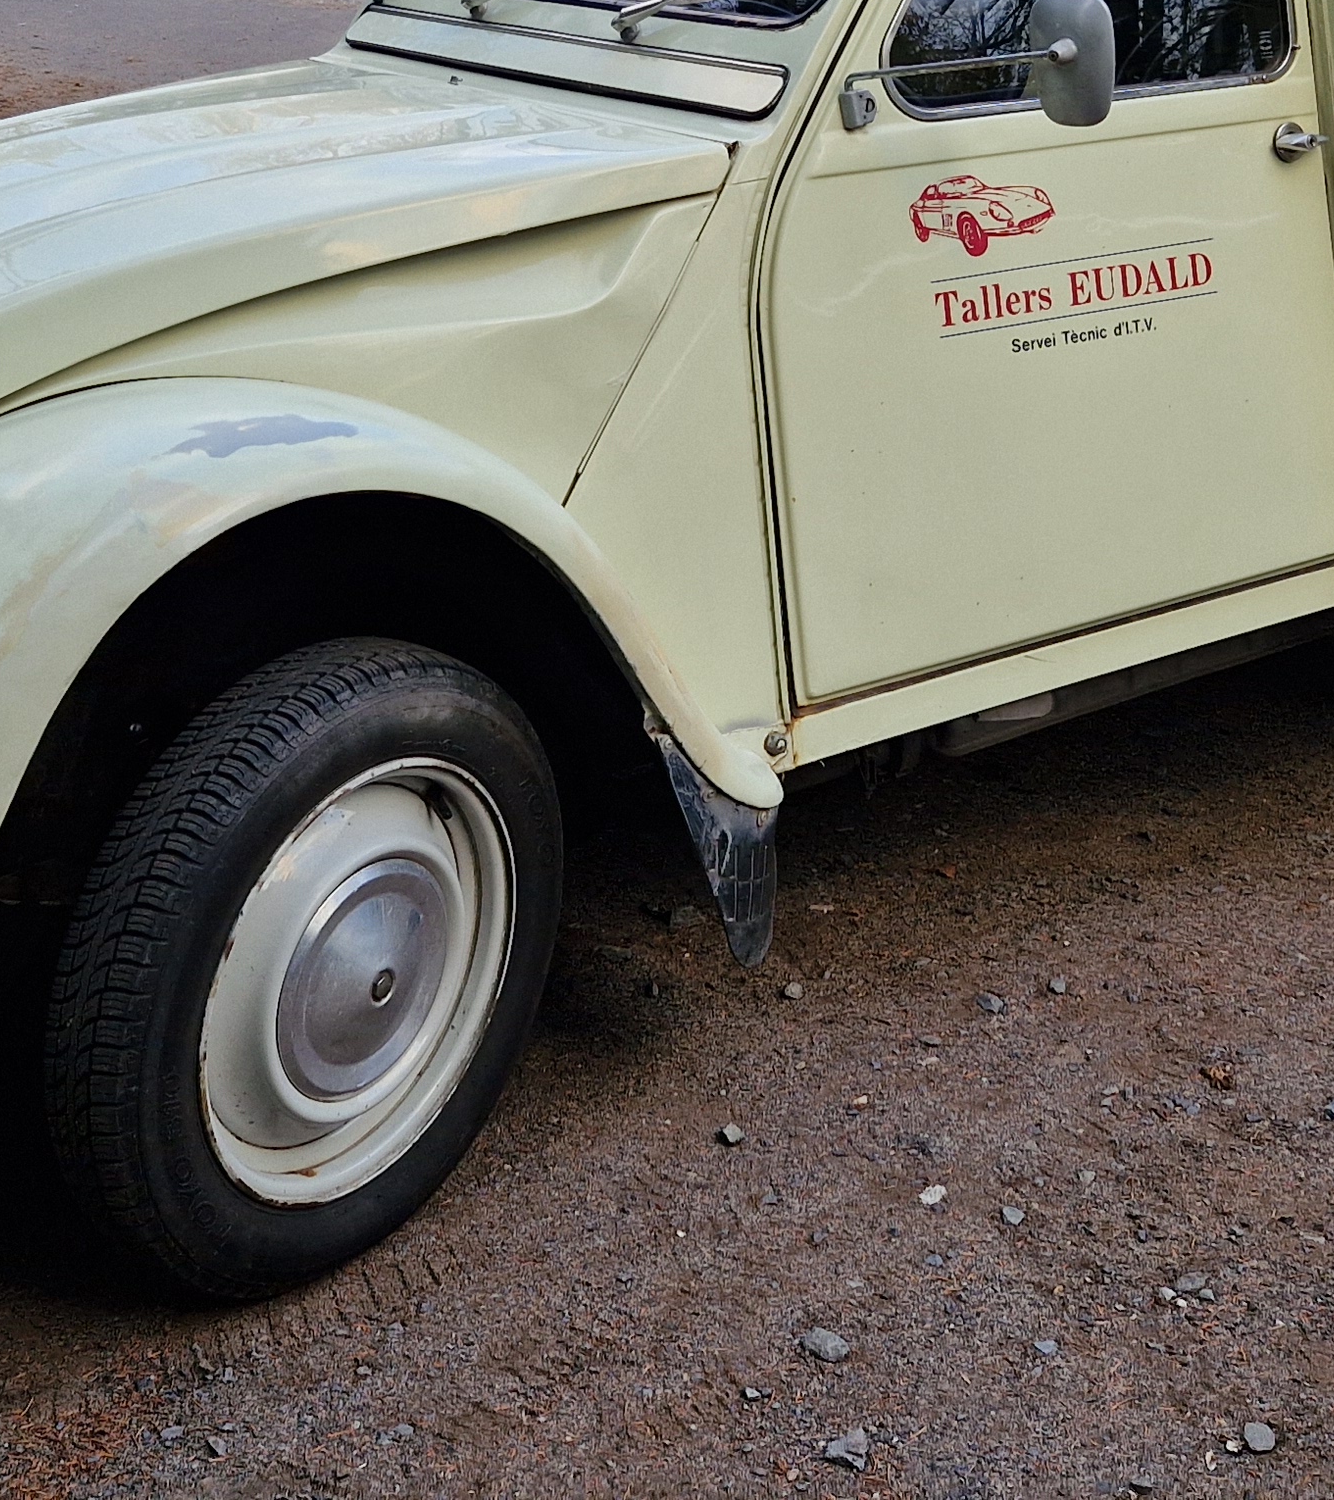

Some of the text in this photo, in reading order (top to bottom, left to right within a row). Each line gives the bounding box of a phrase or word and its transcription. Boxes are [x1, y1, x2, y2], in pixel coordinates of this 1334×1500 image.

[934, 252, 1213, 328] Tallers EUDALD
[1011, 332, 1057, 353] Servei
[1062, 325, 1108, 345] Tècnic
